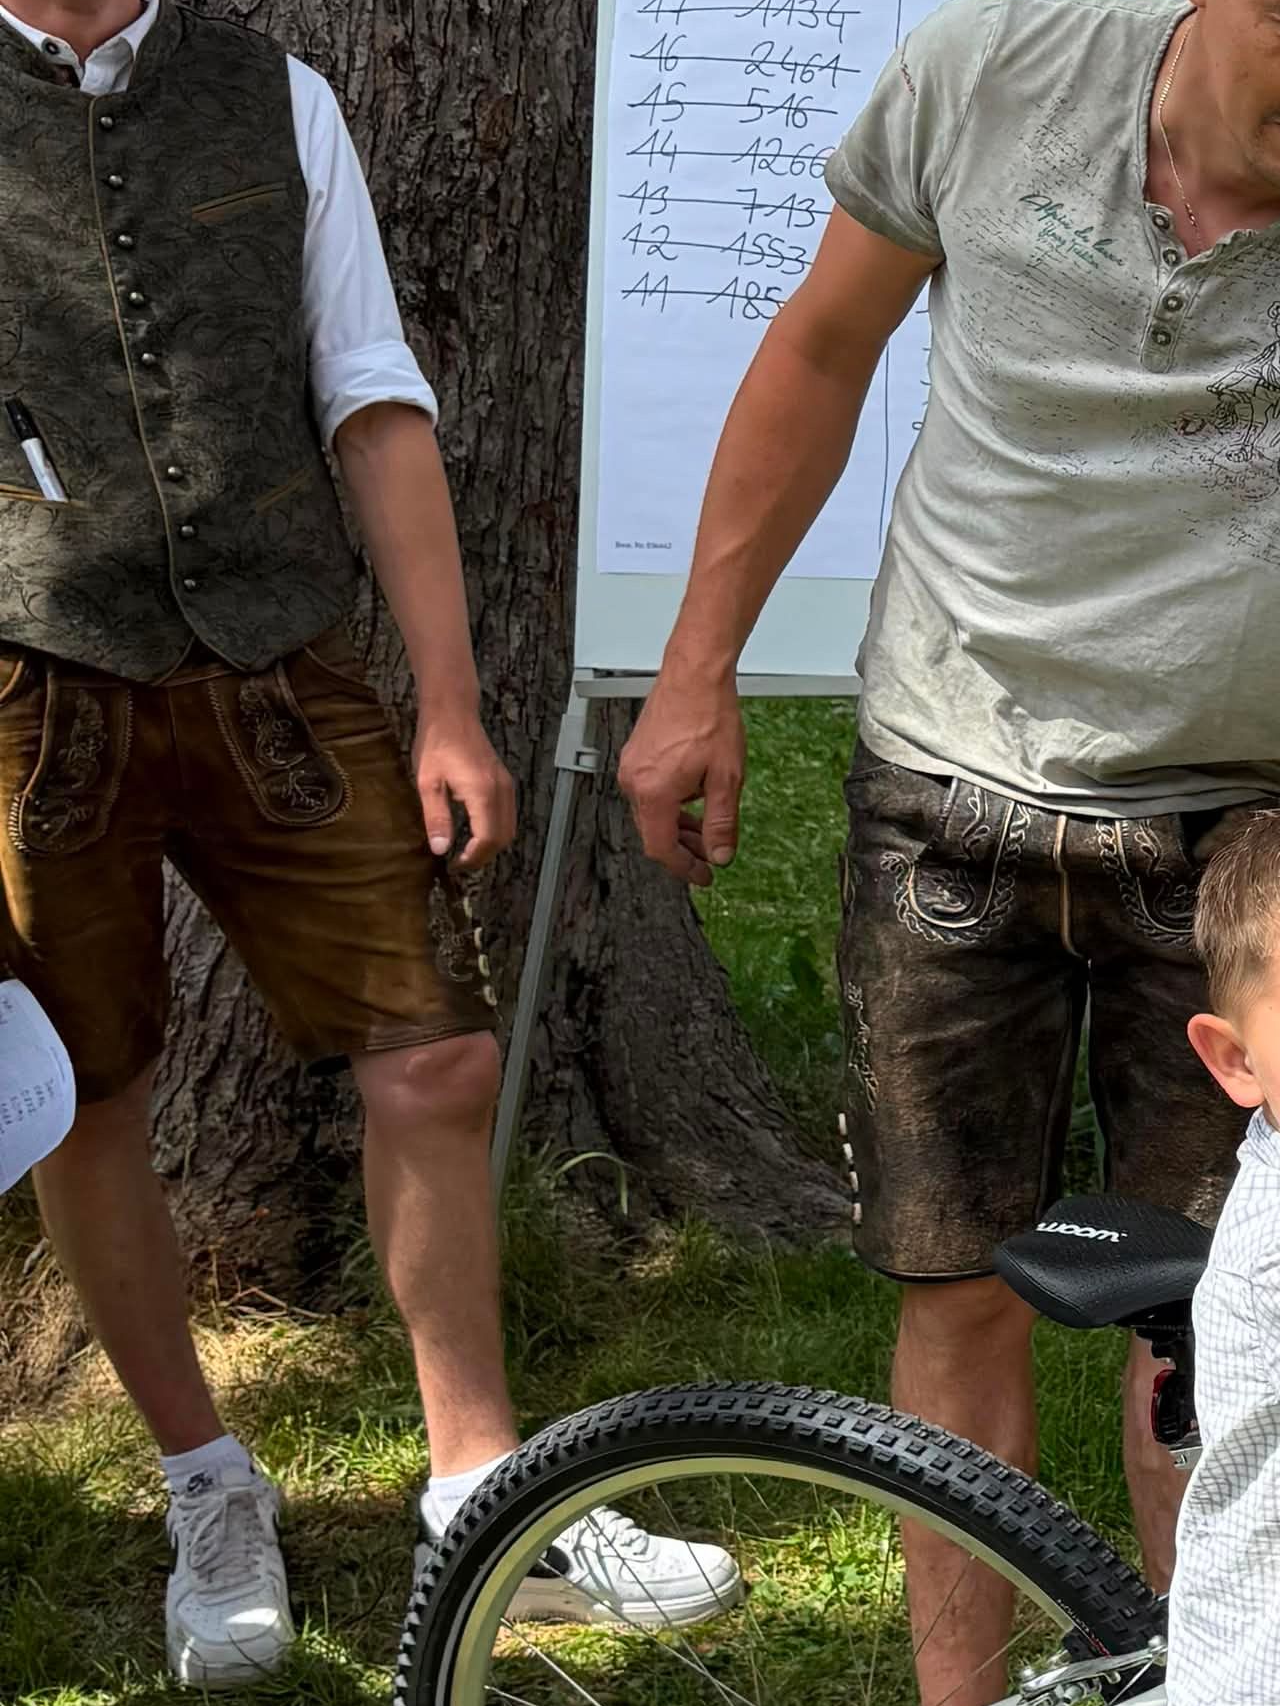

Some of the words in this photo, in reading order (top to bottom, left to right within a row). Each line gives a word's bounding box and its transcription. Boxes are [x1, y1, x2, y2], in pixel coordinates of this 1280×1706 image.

[638, 33, 687, 72] 16
[636, 82, 686, 126] 15
[739, 87, 813, 128] 516
[628, 129, 677, 173] 14
[629, 180, 669, 214] 13
[736, 188, 816, 228] 713
[622, 222, 678, 260] 12
[721, 231, 807, 274] 1553
[622, 272, 669, 312] 11
[1035, 1221, 1122, 1243] woom
